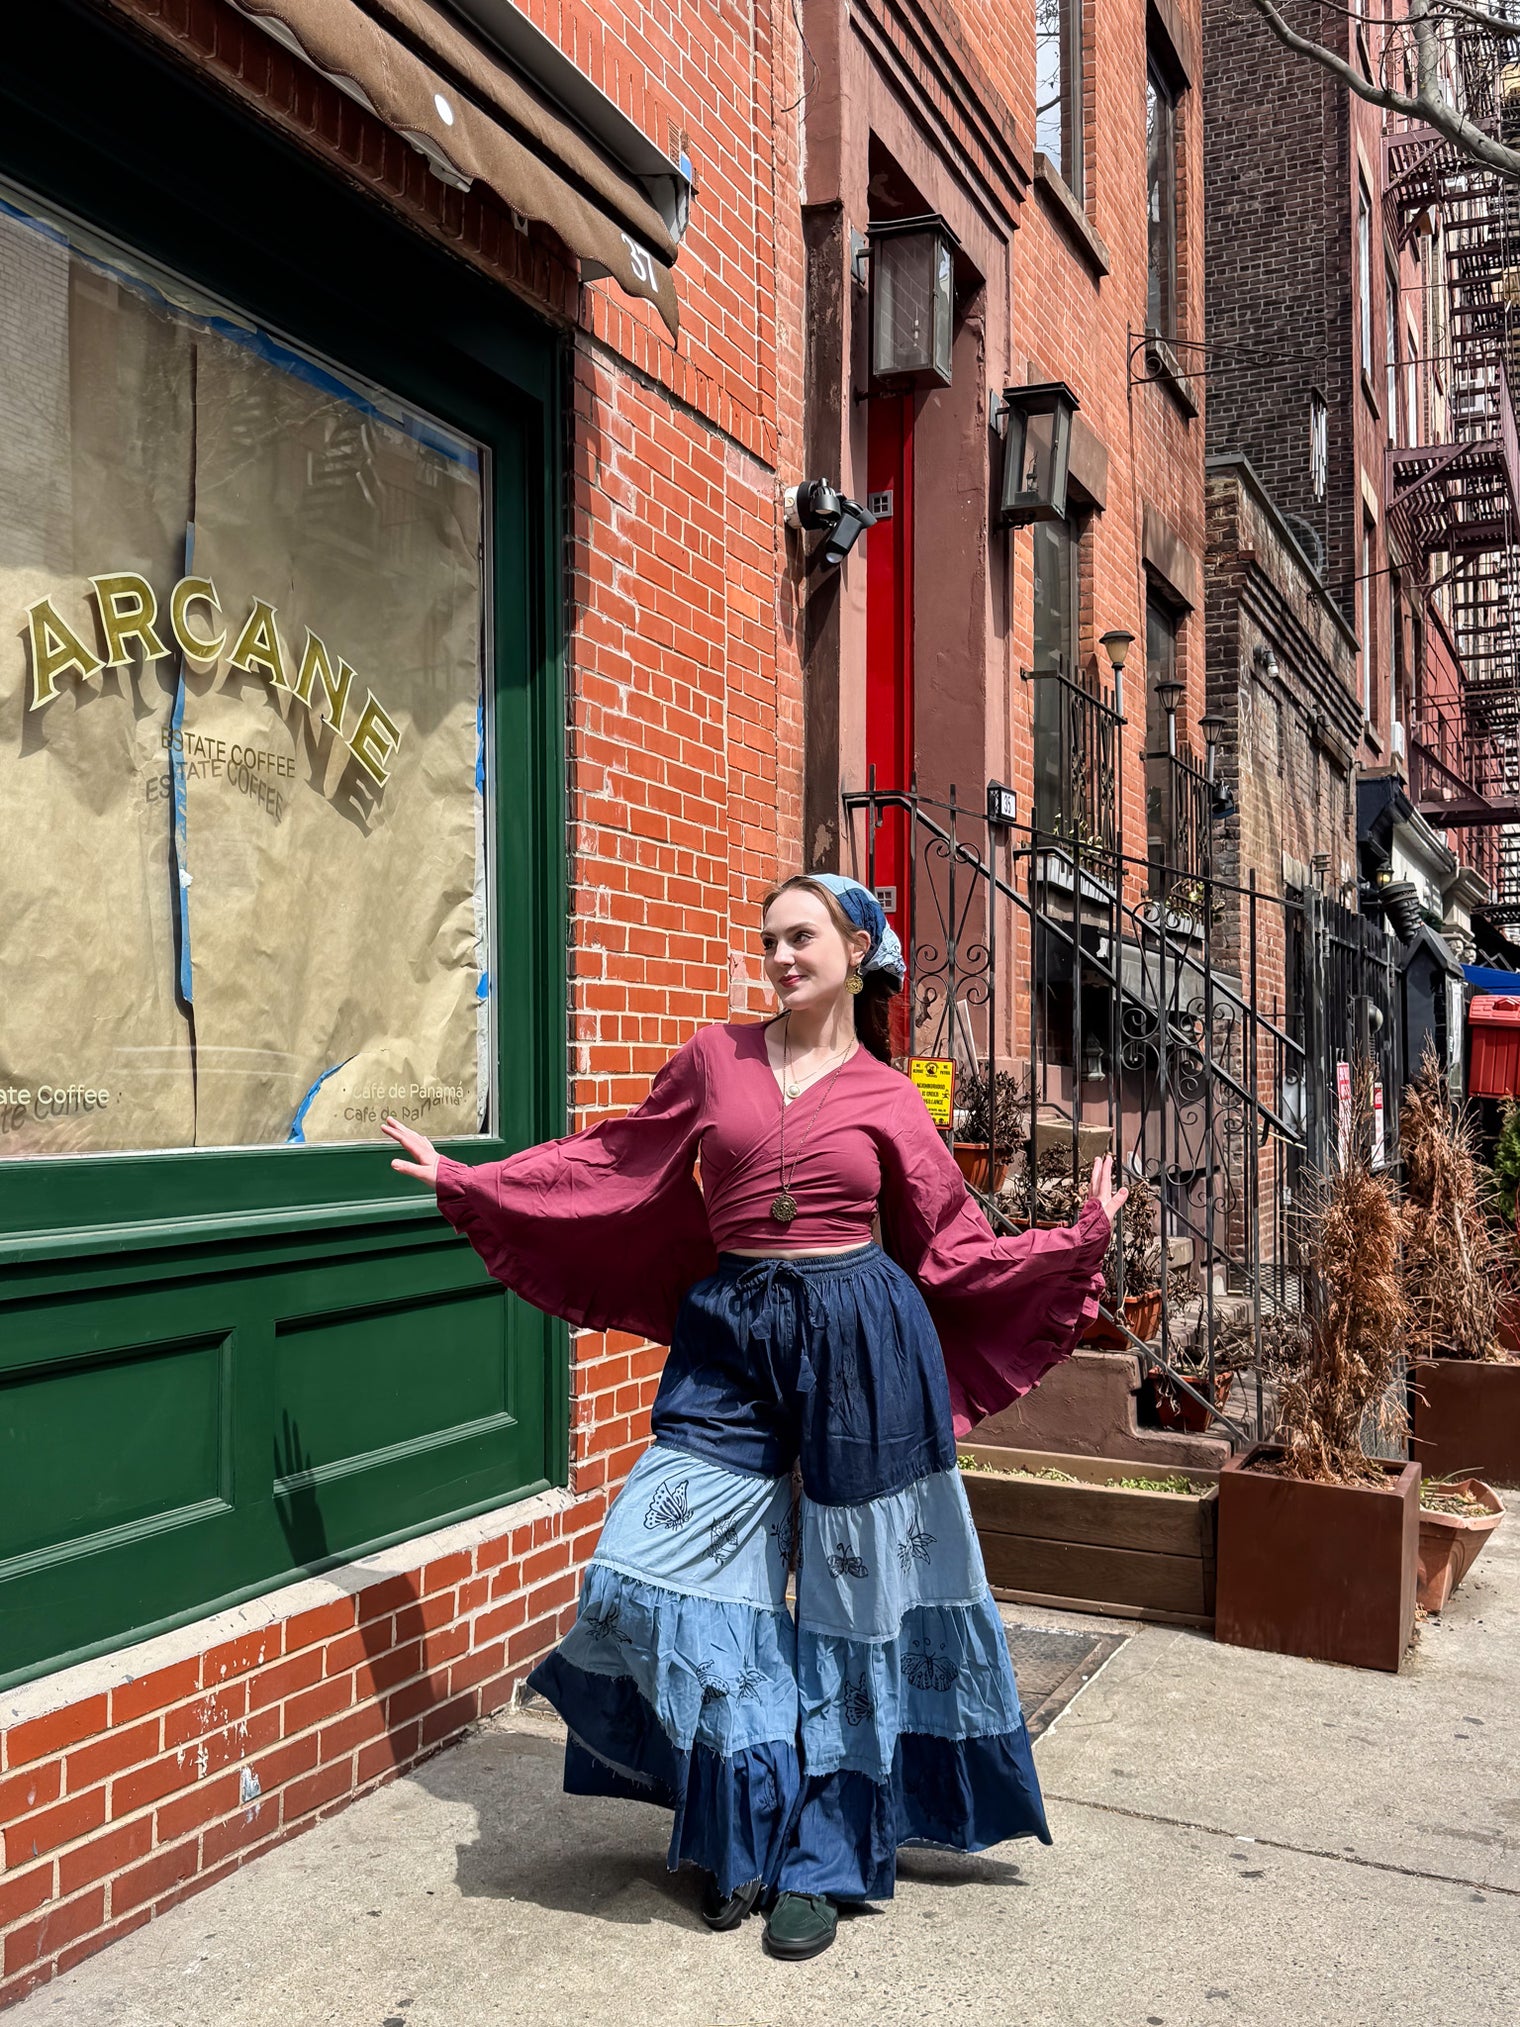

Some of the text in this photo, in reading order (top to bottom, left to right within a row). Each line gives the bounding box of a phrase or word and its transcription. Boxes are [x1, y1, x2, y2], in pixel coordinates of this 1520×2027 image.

[621, 232, 659, 294] 37
[25, 571, 401, 788] ARCANE
[160, 726, 296, 779] ESTATE COFFEE
[37, 1084, 110, 1105] Coffee
[353, 1080, 464, 1099] Café de Panamá
